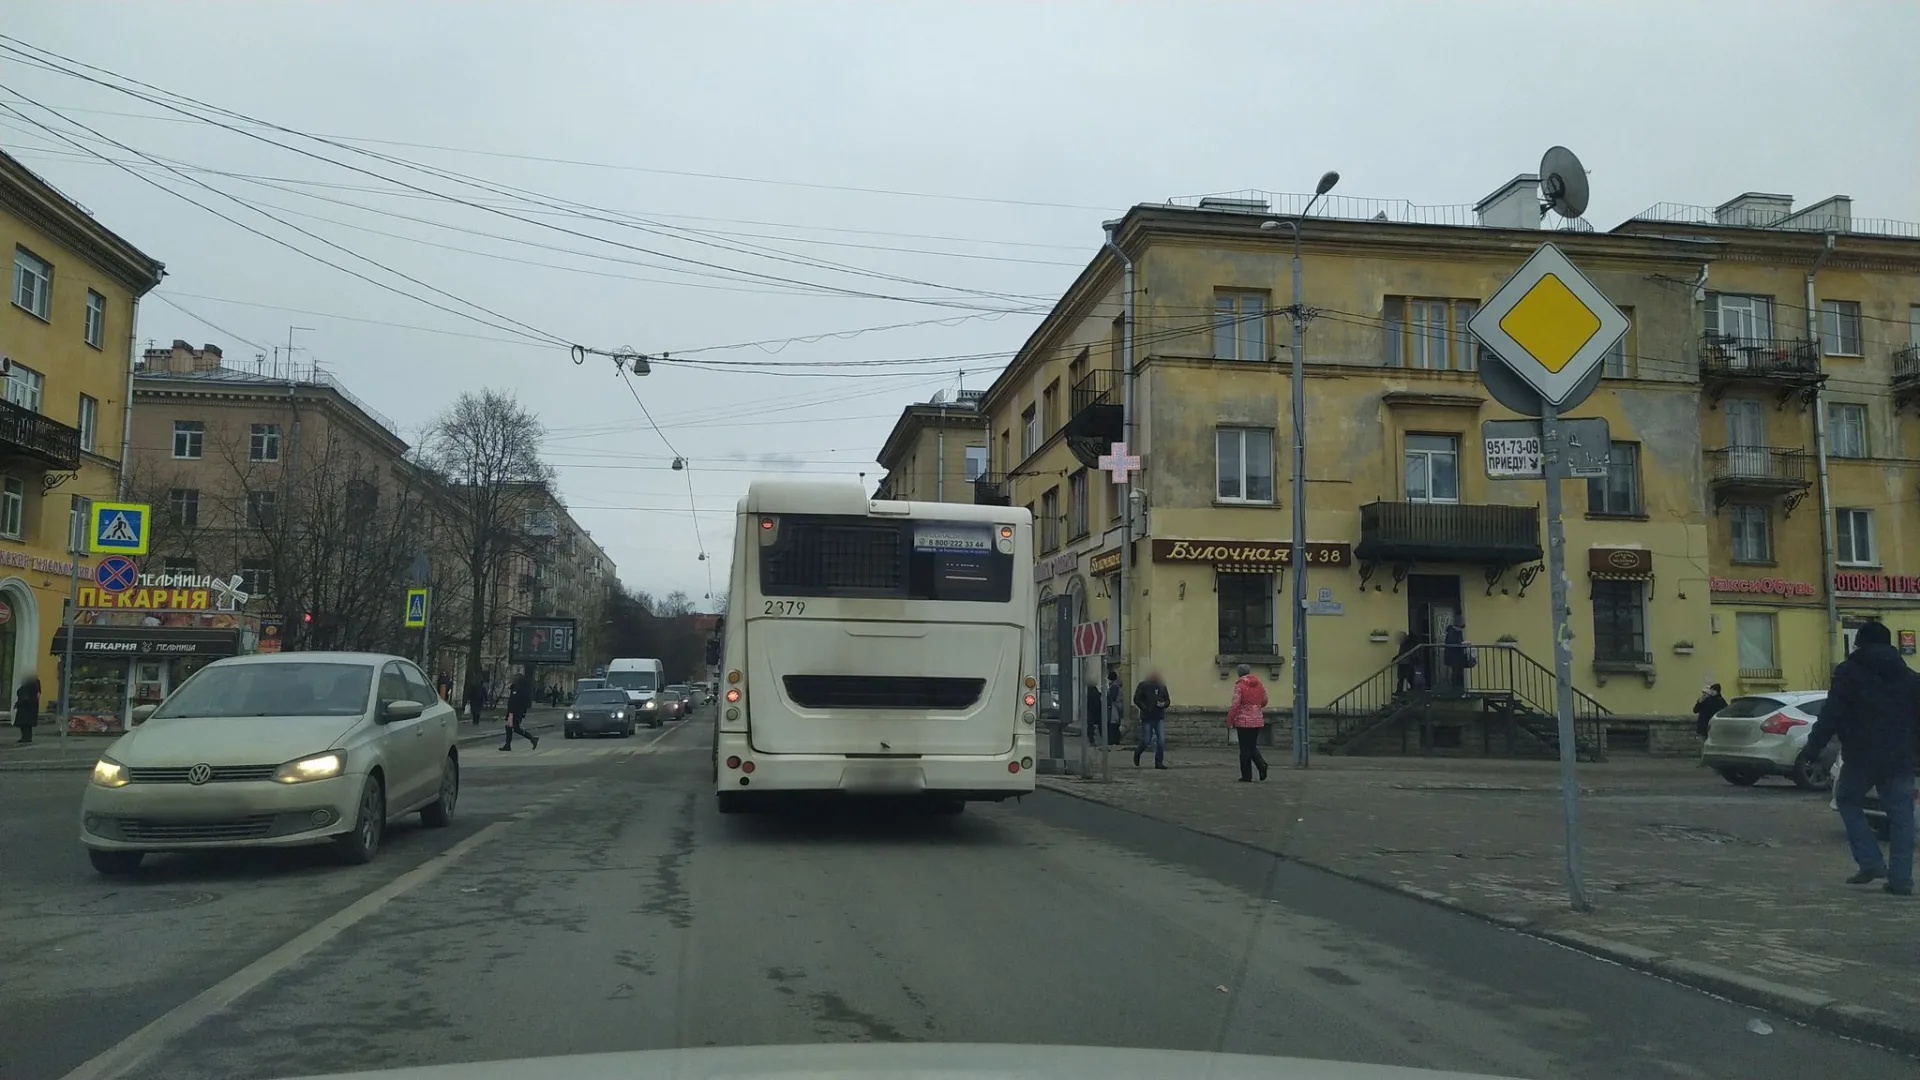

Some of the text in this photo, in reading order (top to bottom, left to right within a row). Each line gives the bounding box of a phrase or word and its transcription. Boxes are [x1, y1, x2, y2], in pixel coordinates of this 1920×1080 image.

[1487, 439, 1539, 454] 951-73-09
[1488, 456, 1526, 471] ПРИЕДУ!
[1319, 549, 1341, 562] 38
[136, 573, 212, 588] МЕЛЬНИЦА
[1834, 571, 1886, 592] ОТОВЫЕ
[78, 586, 208, 609] ПЕКАРНЯ
[764, 600, 806, 616] 2379
[84, 642, 137, 651] ПЕКАРНЯ
